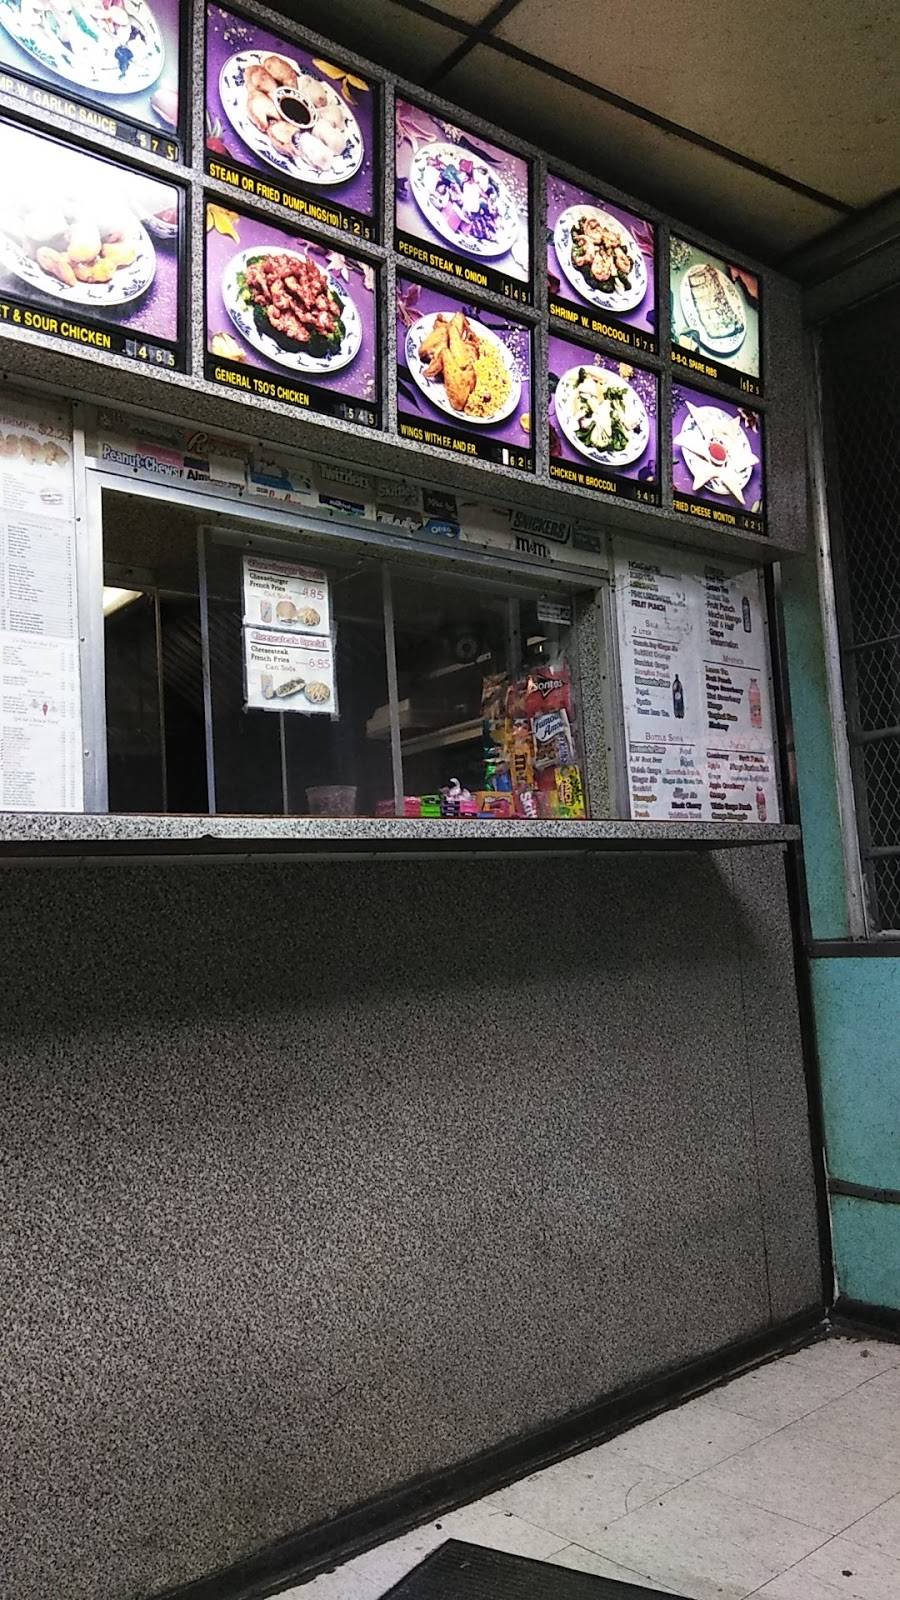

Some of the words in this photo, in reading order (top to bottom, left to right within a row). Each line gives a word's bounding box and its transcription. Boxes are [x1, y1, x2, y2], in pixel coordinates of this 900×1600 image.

[33, 90, 76, 117] GARLIC
[79, 108, 117, 136] SAUCE
[209, 162, 240, 188] STEAM
[242, 177, 254, 192] OR
[256, 182, 281, 201] FRIED
[398, 240, 428, 262] PEPPER
[429, 253, 454, 273] STEAK
[464, 268, 488, 287] ONION
[0, 303, 10, 319] T
[24, 312, 58, 333] SOUR
[60, 322, 111, 349] CHICKEN
[549, 303, 579, 322] SHRIMP
[688, 358, 705, 373] SPARE
[705, 365, 718, 379] RIBS
[214, 367, 252, 389] GENERAL
[253, 378, 276, 397] TSO'S
[276, 386, 310, 406] CHICKEN
[400, 423, 423, 440] WINGS
[424, 431, 442, 445] WITH
[452, 439, 467, 452] AND
[549, 465, 577, 481] CHICKEN
[585, 475, 617, 492] BROCCOLI
[513, 510, 567, 539] SNICKERS
[672, 500, 689, 512] FRIED
[690, 504, 712, 519] CHEESE
[712, 510, 736, 525] WONTON
